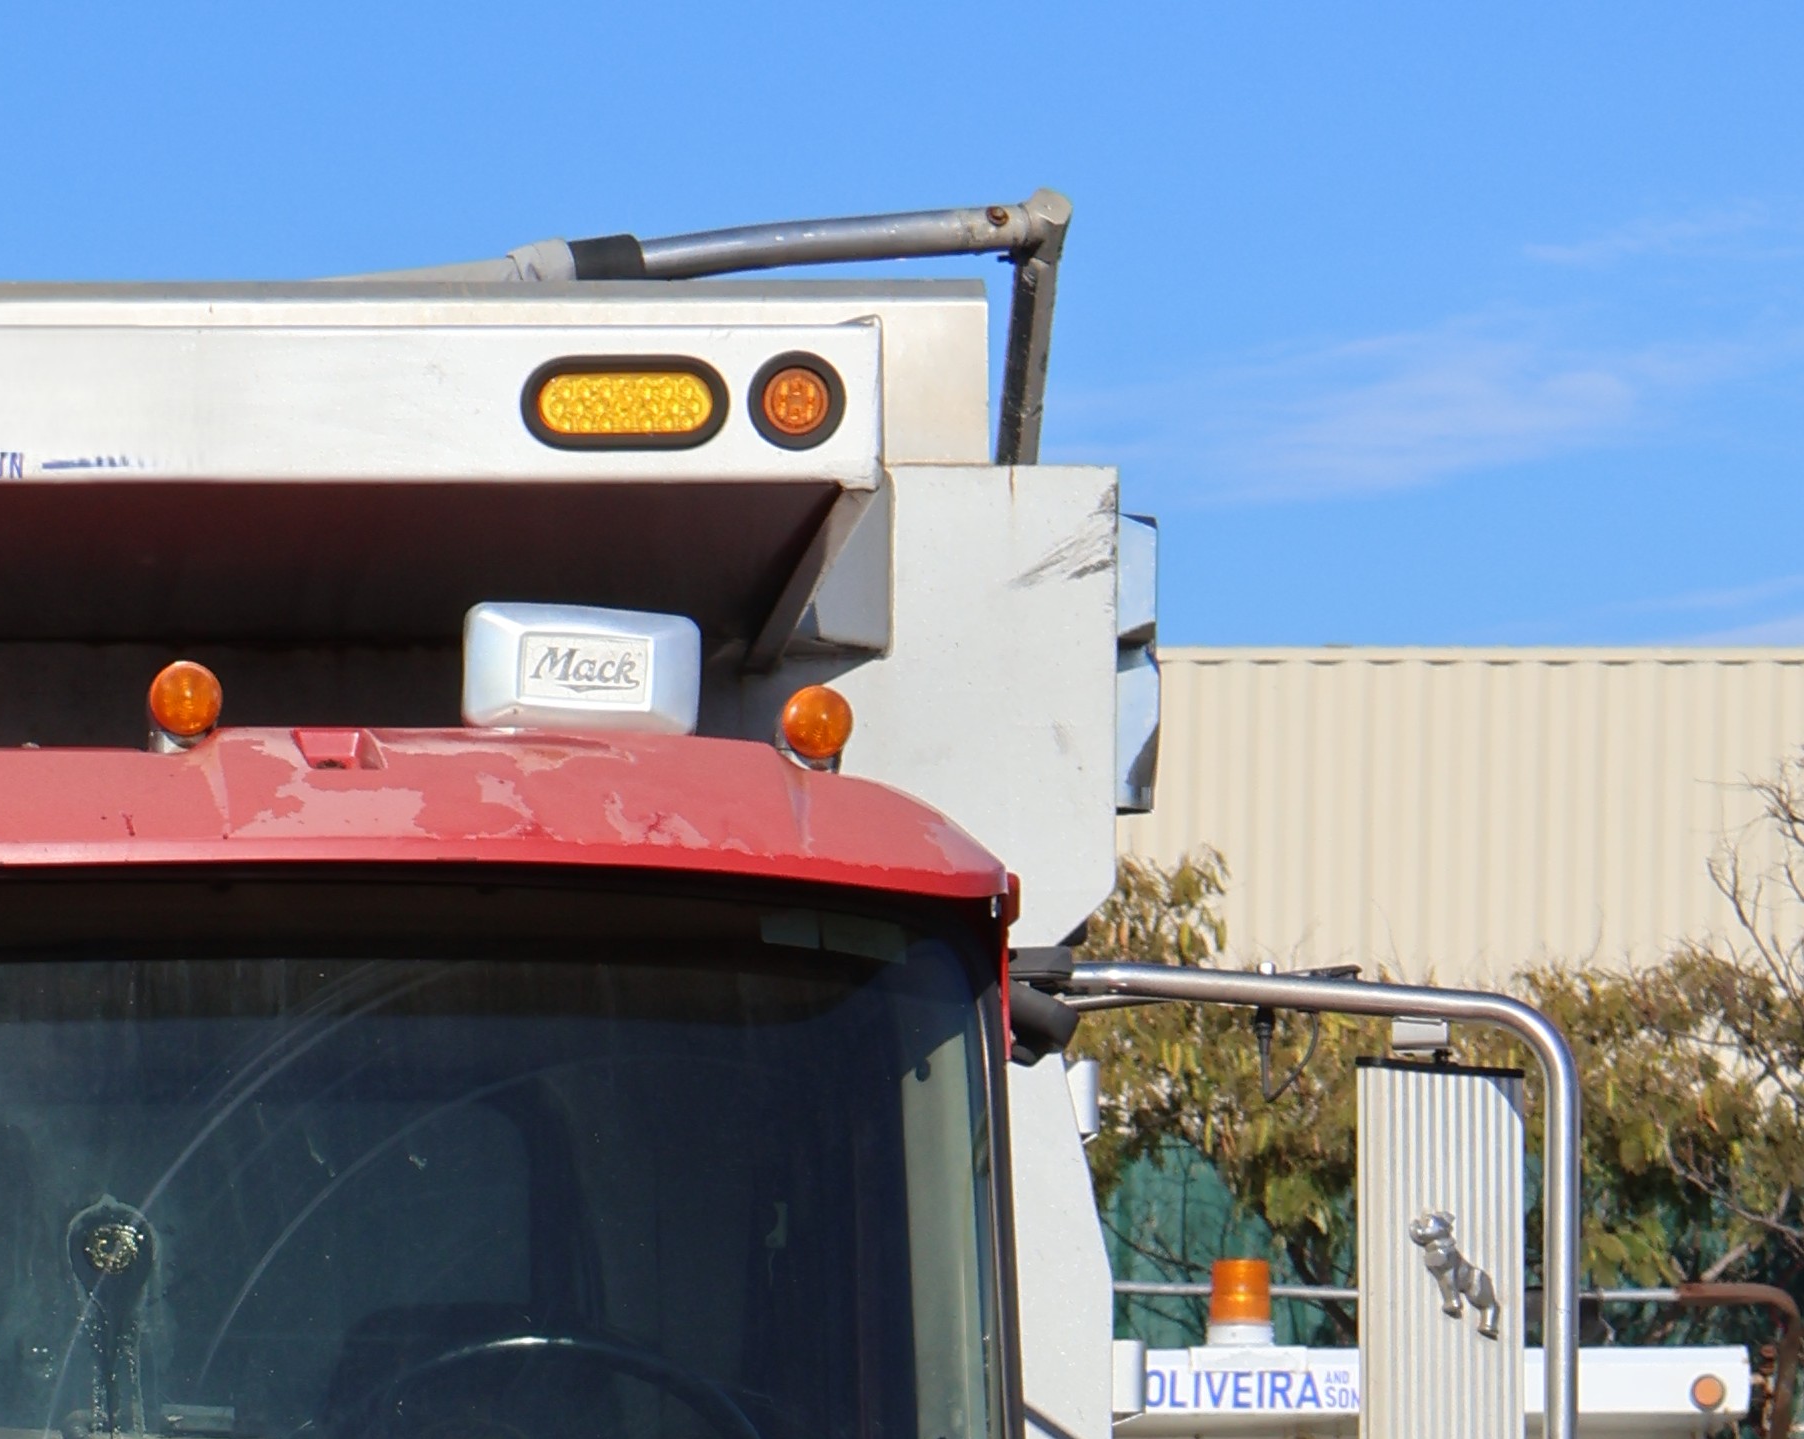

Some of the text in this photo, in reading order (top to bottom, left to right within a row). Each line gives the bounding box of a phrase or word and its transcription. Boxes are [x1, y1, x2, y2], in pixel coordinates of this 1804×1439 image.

[529, 646, 640, 690] Mack
[1146, 1370, 1322, 1409] OLIVEIRA
[1324, 1370, 1350, 1384] AND
